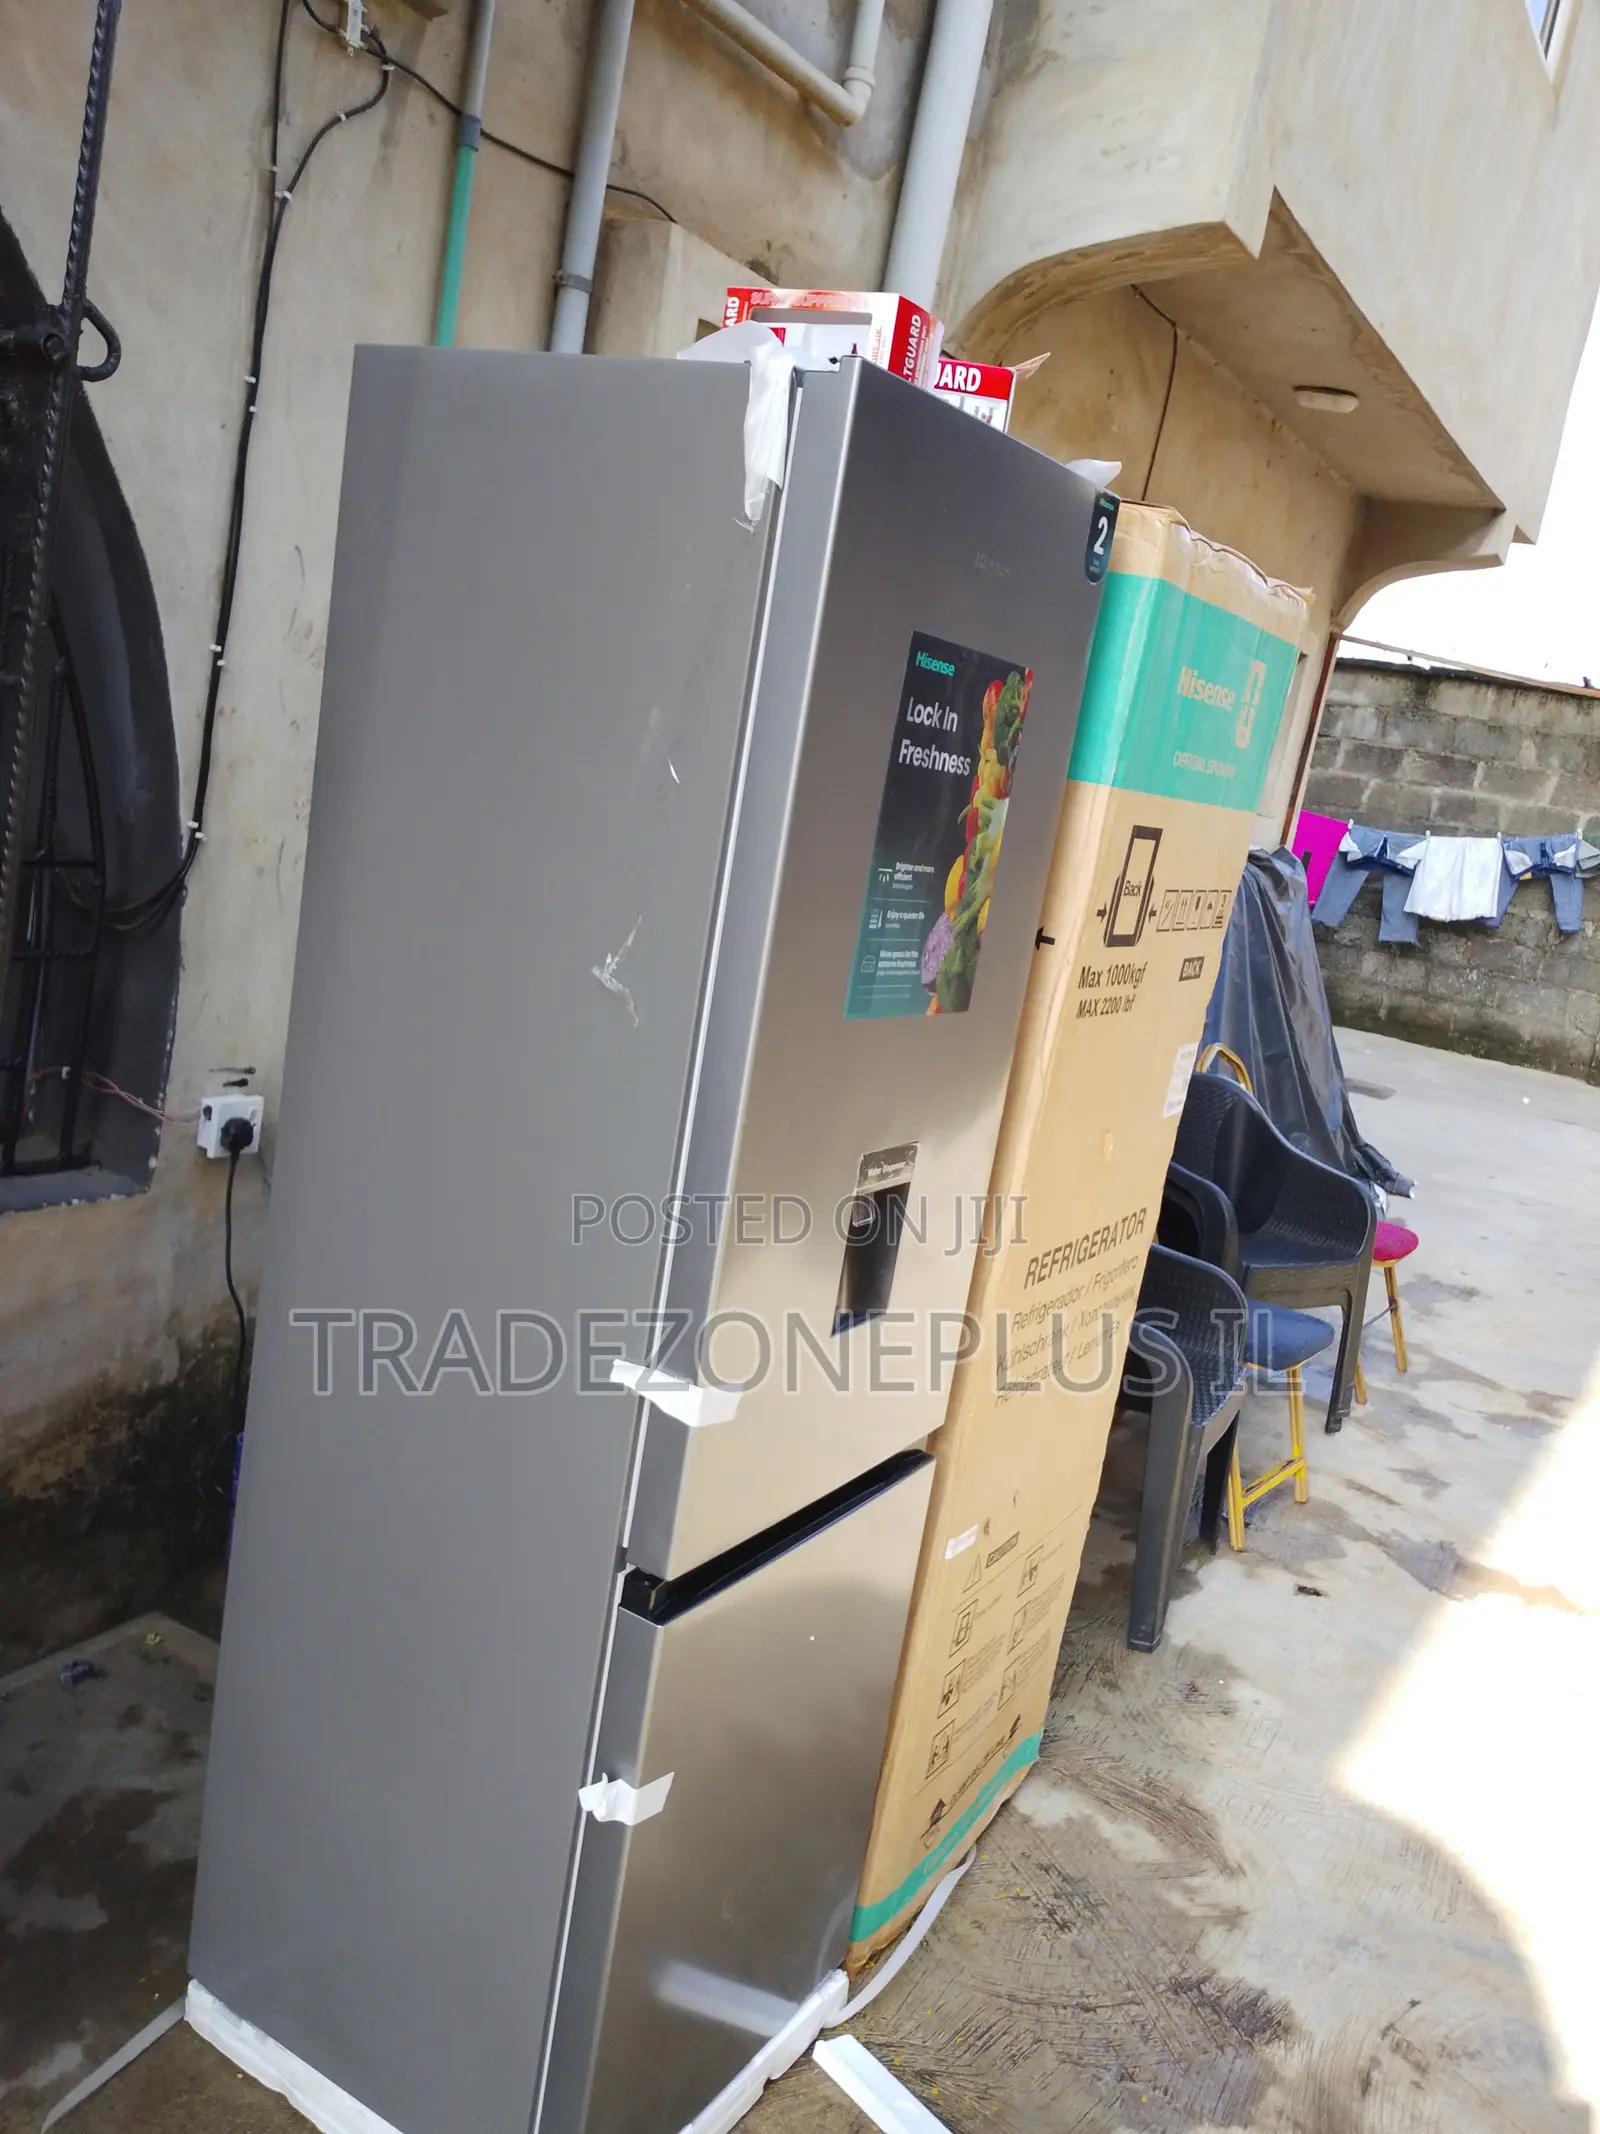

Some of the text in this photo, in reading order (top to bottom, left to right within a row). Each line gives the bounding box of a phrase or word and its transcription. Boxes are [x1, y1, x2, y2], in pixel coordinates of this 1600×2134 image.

[903, 313, 922, 382] TGUARD
[1093, 515, 1108, 555] 2
[915, 651, 955, 677] Hisense
[1177, 665, 1236, 712] Hisense
[906, 696, 940, 729] Lock
[898, 737, 971, 777] Freshness
[1123, 880, 1143, 898] Back
[1077, 961, 1148, 989] Max 1000kgf
[1182, 960, 1202, 978] BACK
[1076, 993, 1136, 1019] MAX 2200 lbf
[1023, 1206, 1147, 1289] REFRIGERATOR
[1011, 1282, 1085, 1334] Refrigerador
